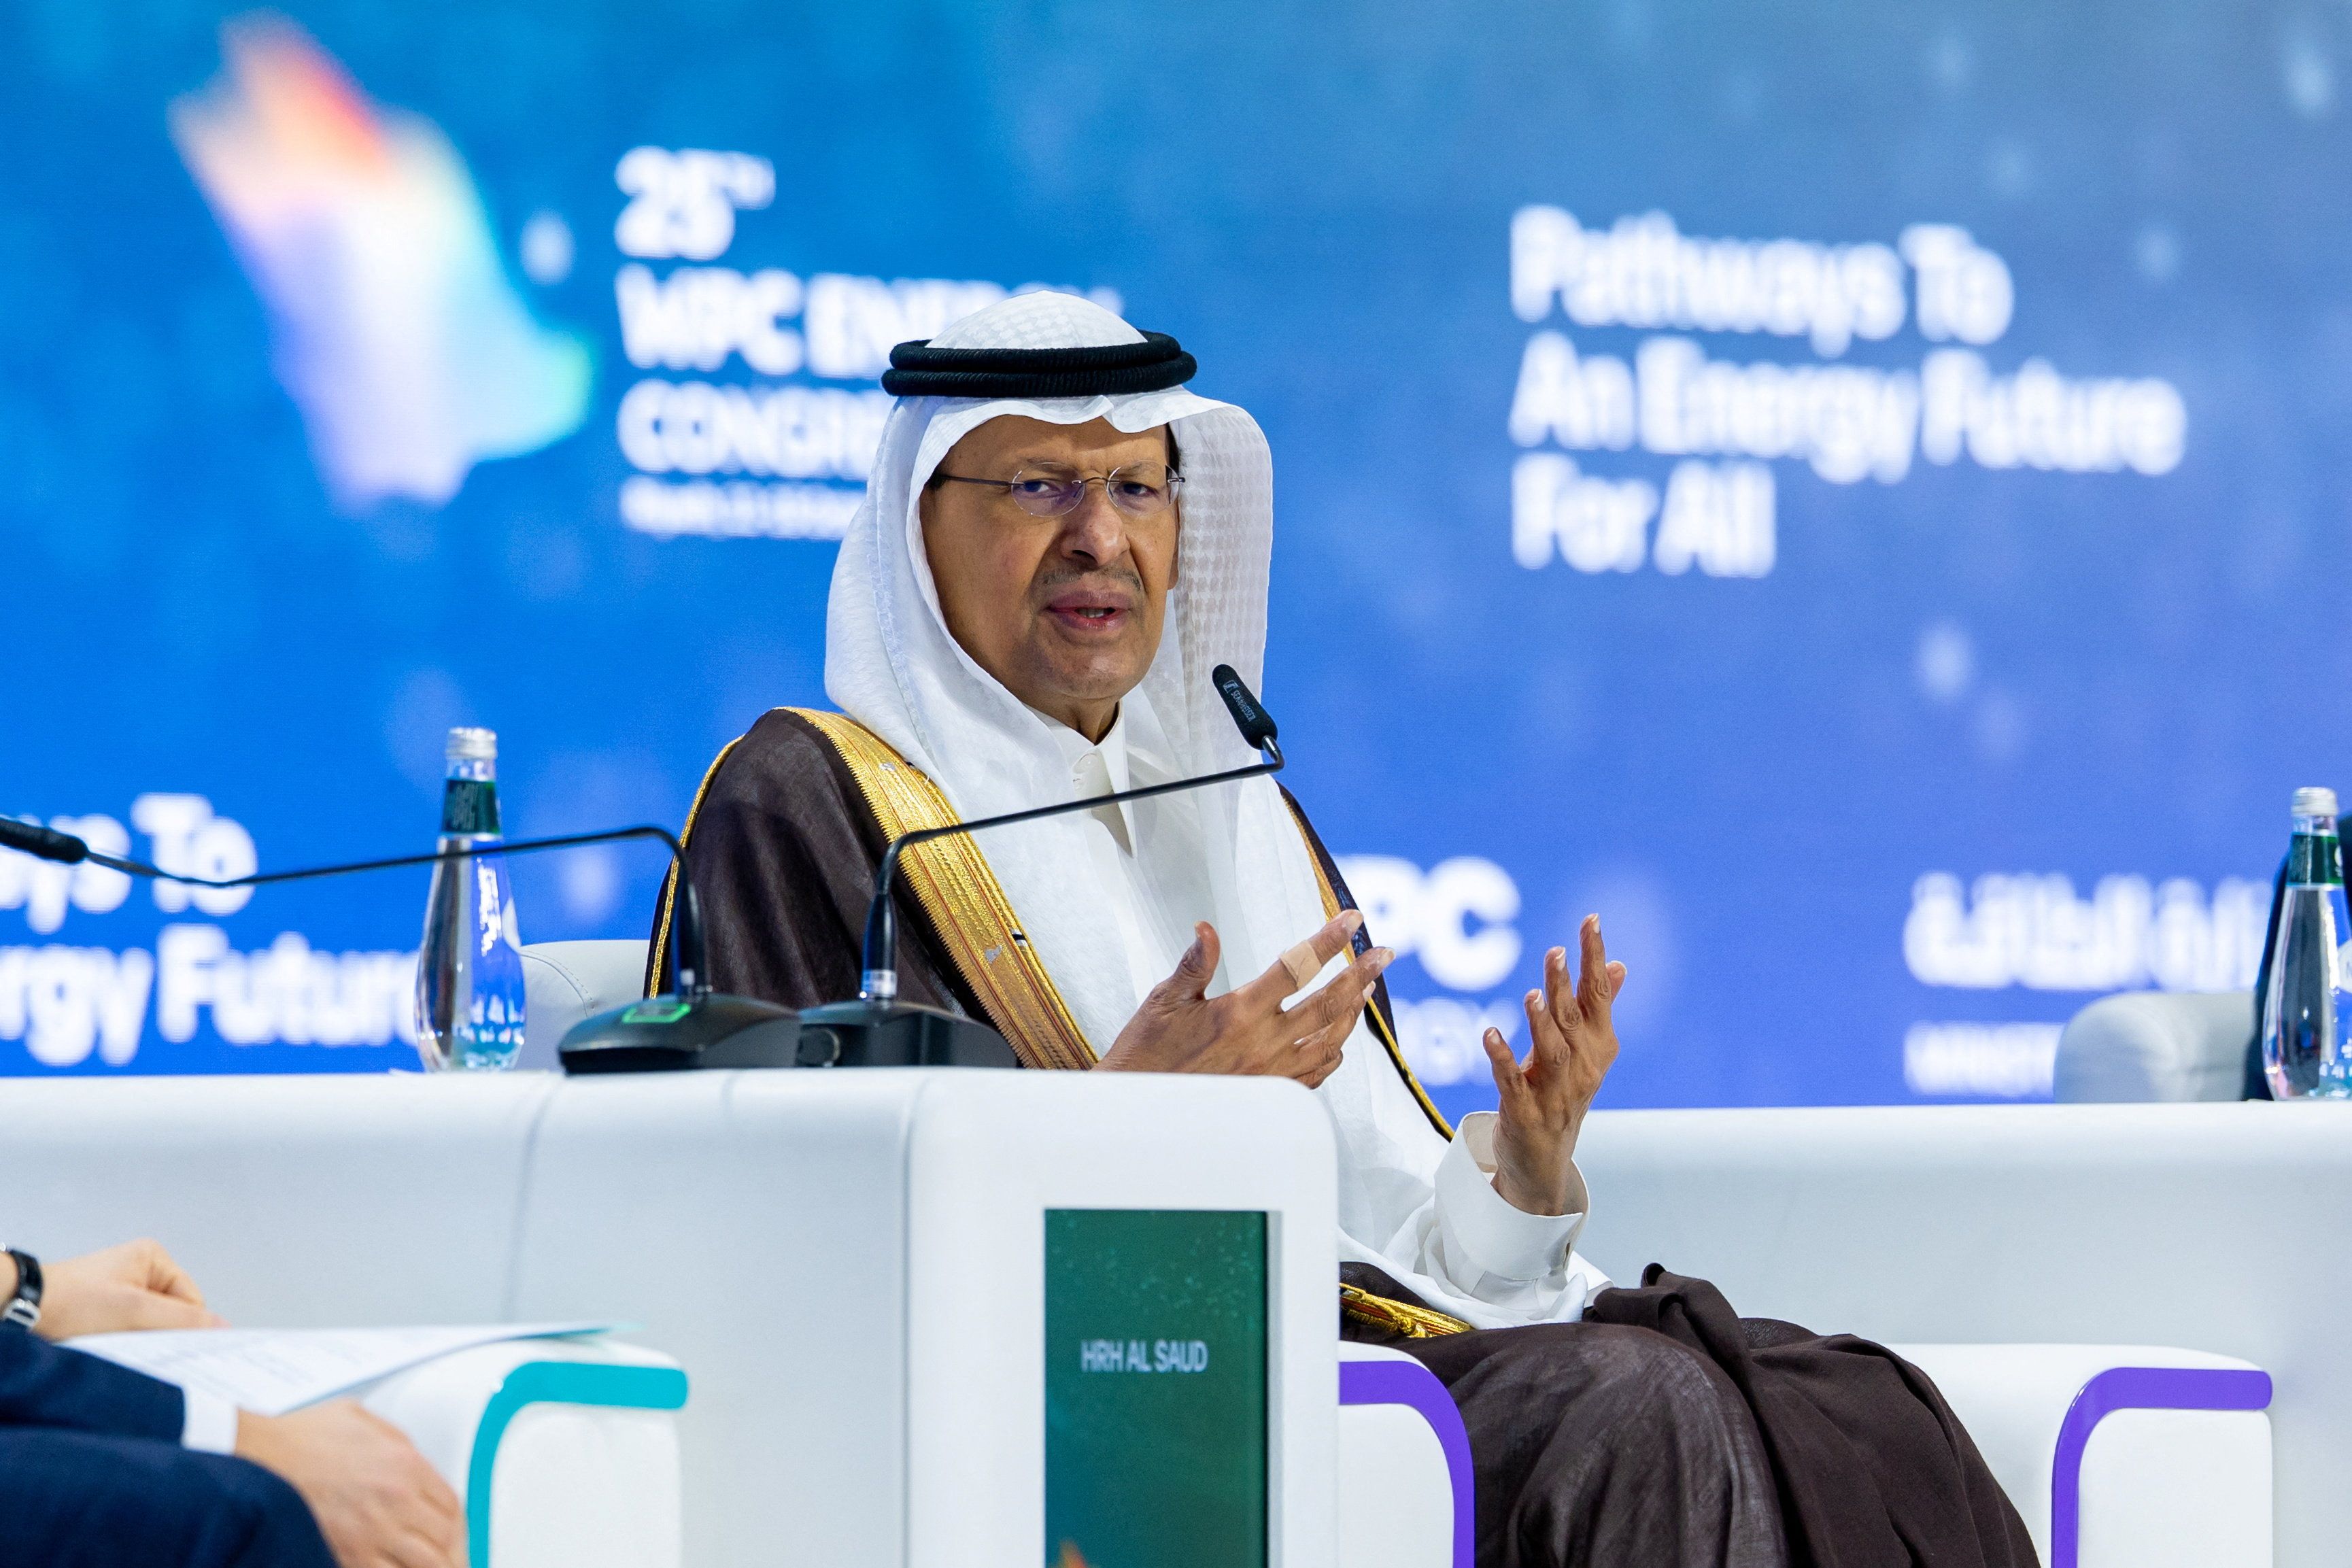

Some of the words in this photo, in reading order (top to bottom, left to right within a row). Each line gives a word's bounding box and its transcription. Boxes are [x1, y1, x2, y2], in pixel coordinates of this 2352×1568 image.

[616, 265, 803, 375] WPC
[1511, 206, 1903, 358] Pathways
[1902, 225, 2013, 345] To
[1510, 332, 1633, 450] An
[1637, 337, 1919, 484] Energy
[1922, 349, 2185, 475] Future
[1512, 454, 1659, 573] For
[1654, 460, 1776, 577] All
[131, 793, 257, 915] To
[1336, 855, 1522, 991] PC
[1081, 1339, 1123, 1371] HRH
[1125, 1340, 1153, 1371] AL
[1154, 1339, 1208, 1373] SAUD
